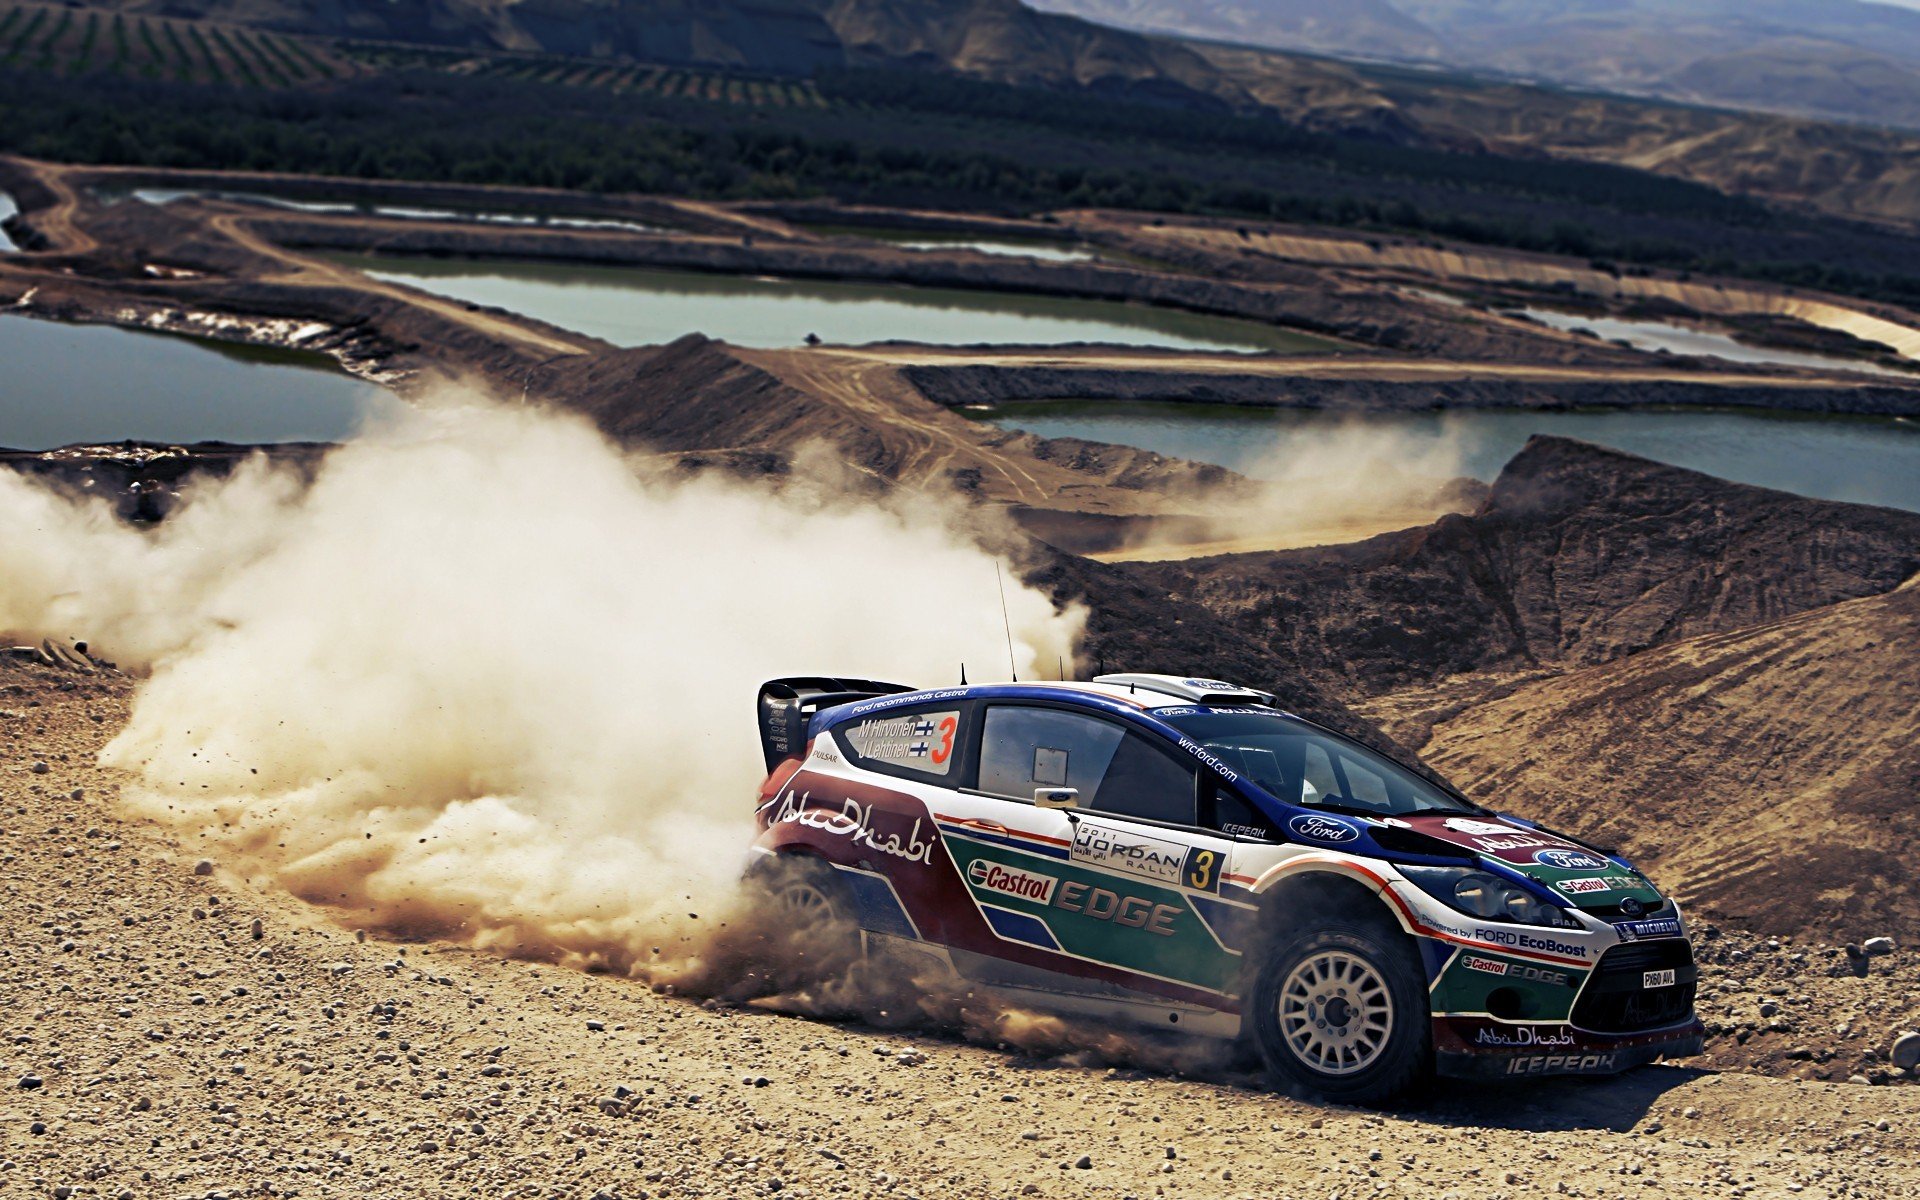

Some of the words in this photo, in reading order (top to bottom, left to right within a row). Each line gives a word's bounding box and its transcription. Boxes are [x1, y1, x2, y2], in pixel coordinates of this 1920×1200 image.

[852, 702, 873, 714] Ford
[873, 692, 933, 709] recommends
[934, 689, 969, 699] Castrol
[858, 720, 871, 738] M
[871, 719, 915, 738] Hirvonen
[858, 741, 867, 759] J
[867, 740, 909, 759] Lehtinen
[931, 716, 956, 764] 3
[812, 750, 838, 763] PULSAR
[1178, 737, 1238, 782] wrcford.com
[1081, 828, 1116, 840] 2011
[1222, 822, 1266, 838] ICEPEAK
[1300, 817, 1347, 840] Ford
[1076, 836, 1180, 868] JORDAN
[1551, 851, 1600, 868] Ford
[1126, 860, 1176, 877] RALLY
[1191, 850, 1215, 889] 3
[1571, 879, 1606, 892] Castrol
[987, 866, 1050, 901] Castrol
[1054, 881, 1184, 936] EDGE
[1552, 918, 1579, 928] PIAA
[1635, 921, 1679, 935] MICHELIN
[1421, 914, 1456, 933] Powered
[1459, 929, 1472, 939] by
[1475, 929, 1517, 945] FORD
[1519, 935, 1586, 957] EcoBoost
[1472, 958, 1505, 975] Castrol
[1507, 965, 1567, 986] EDGE
[1506, 1055, 1616, 1075] ICEPEAK
